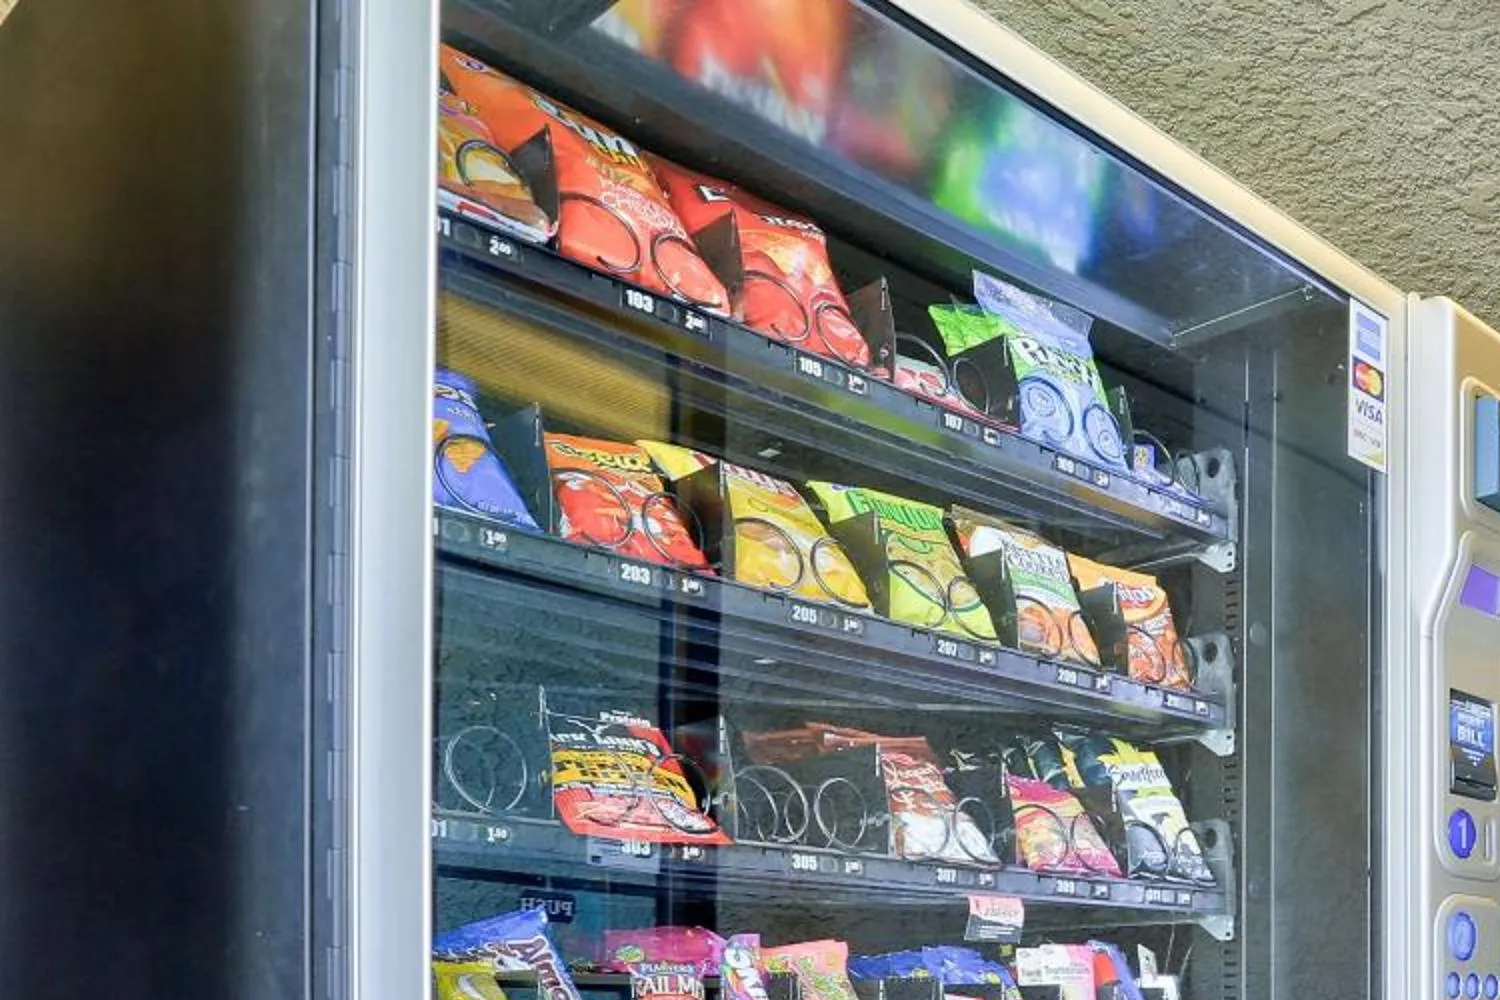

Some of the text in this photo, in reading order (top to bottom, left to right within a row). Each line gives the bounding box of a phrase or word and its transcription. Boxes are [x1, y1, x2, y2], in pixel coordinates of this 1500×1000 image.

[1355, 398, 1383, 425] VISA
[621, 563, 650, 585] 203
[792, 605, 817, 624] 205
[1458, 816, 1468, 849] 1
[791, 854, 818, 871] 305
